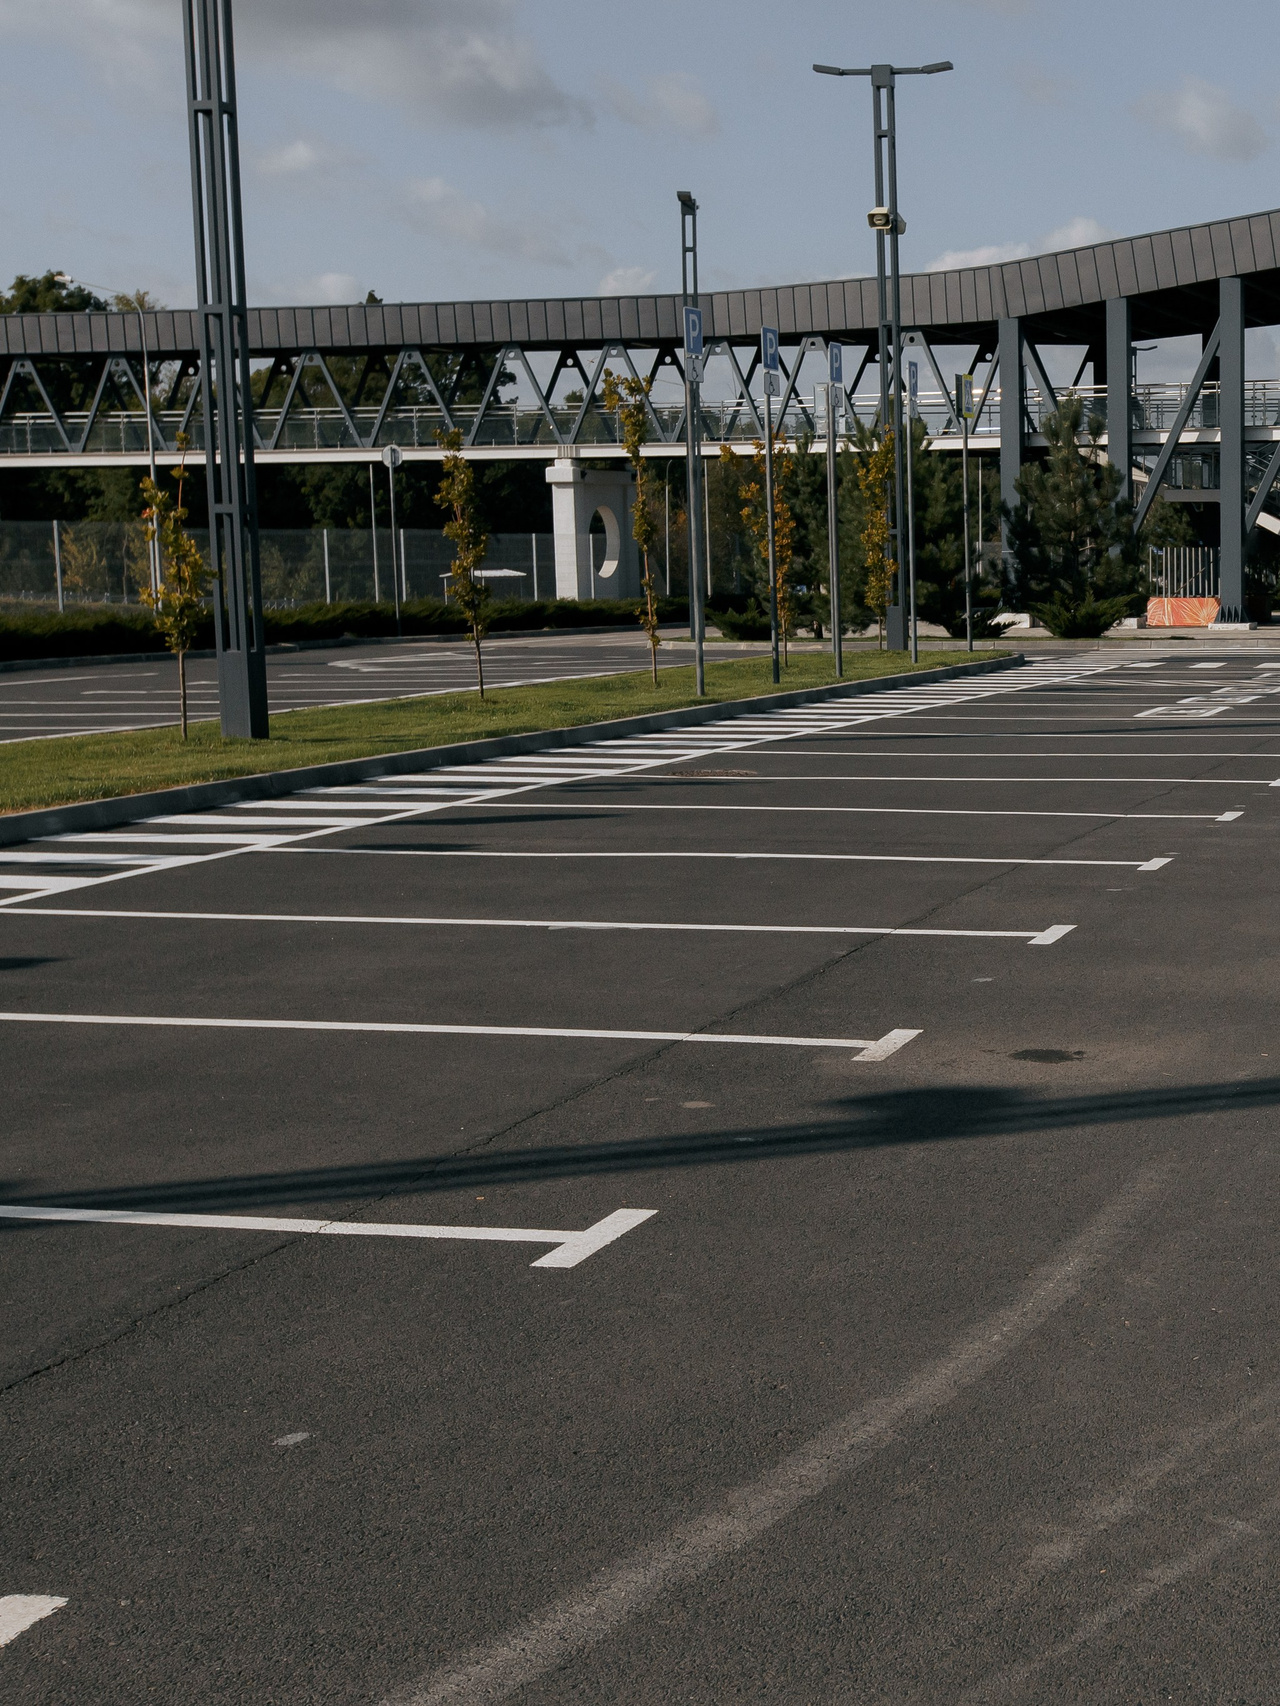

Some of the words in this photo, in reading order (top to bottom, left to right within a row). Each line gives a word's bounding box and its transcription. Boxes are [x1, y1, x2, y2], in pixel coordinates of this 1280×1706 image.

[689, 313, 699, 349] P
[766, 332, 776, 365] P
[832, 347, 840, 378] P
